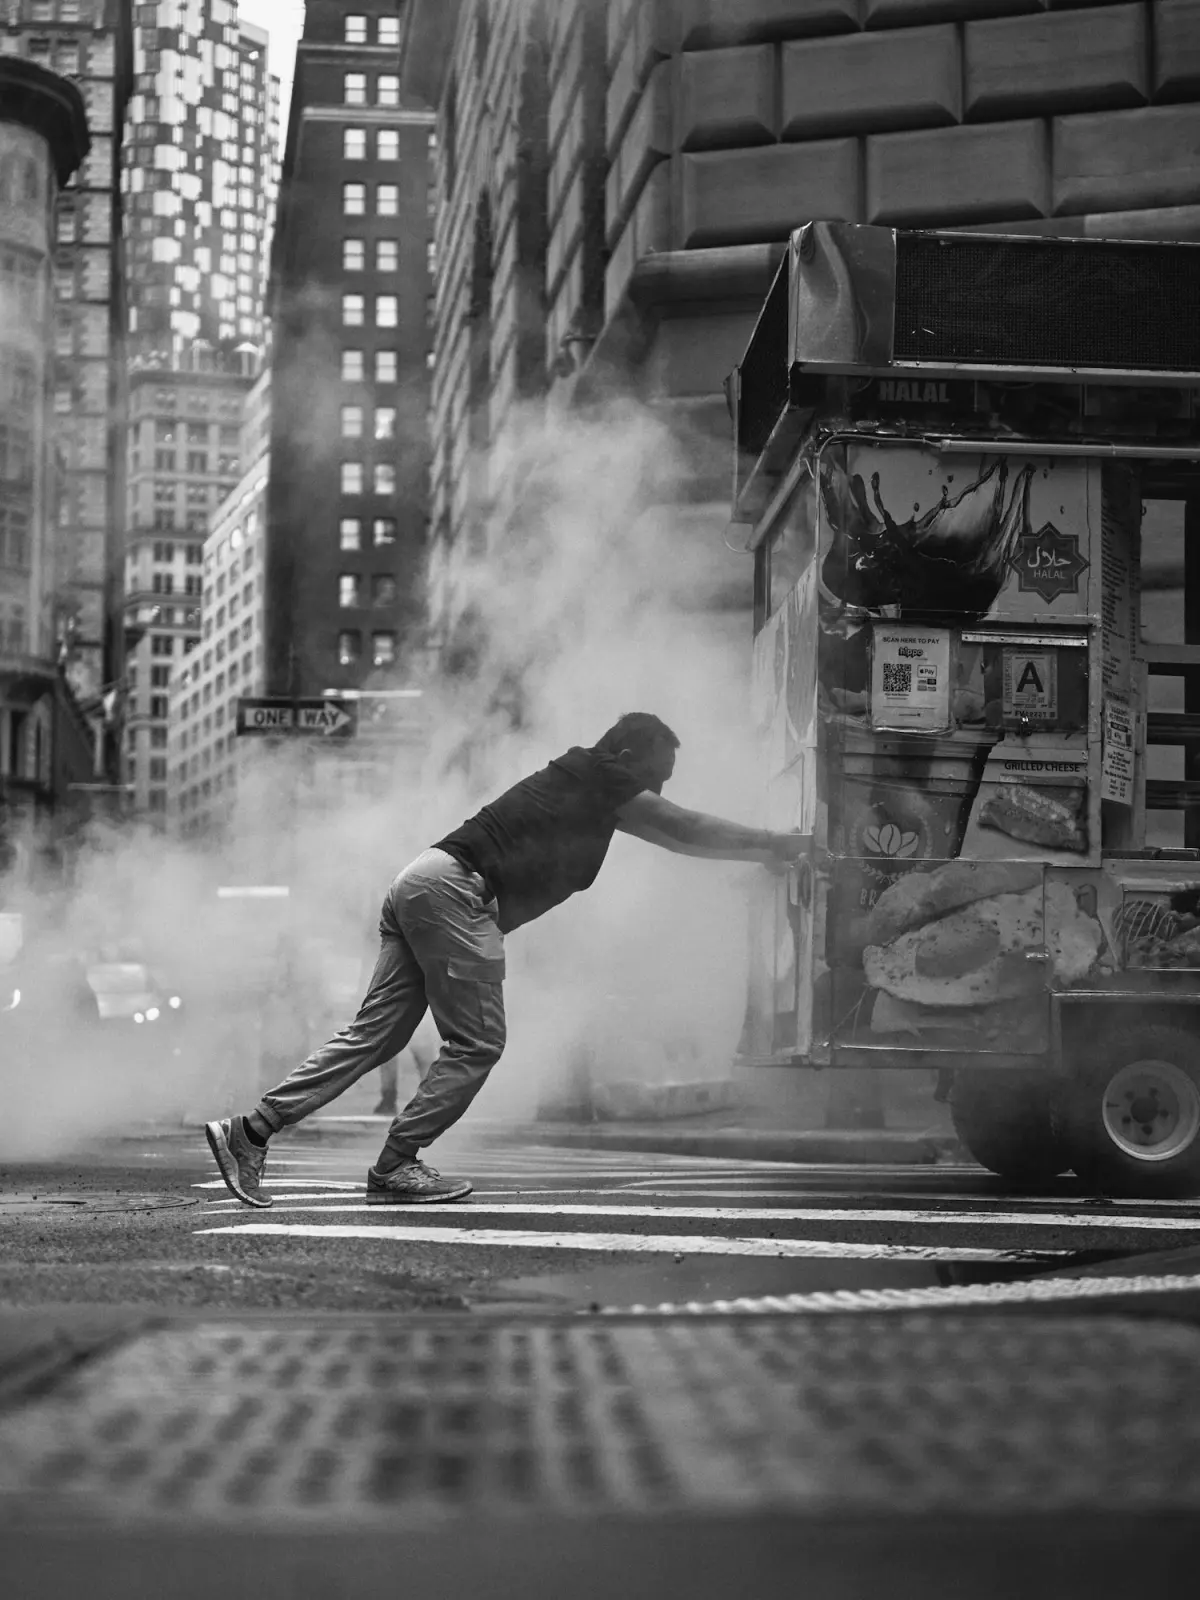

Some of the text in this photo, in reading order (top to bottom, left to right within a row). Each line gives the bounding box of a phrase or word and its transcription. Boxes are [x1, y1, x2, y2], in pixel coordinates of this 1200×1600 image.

[879, 381, 950, 402] HALAL
[1027, 546, 1072, 568] حلال
[1033, 570, 1066, 579] HALAL
[898, 646, 924, 658] hippo
[1016, 661, 1044, 692] A
[254, 708, 340, 727] ONE WAY
[1004, 762, 1080, 773] GRILLED CHEESE
